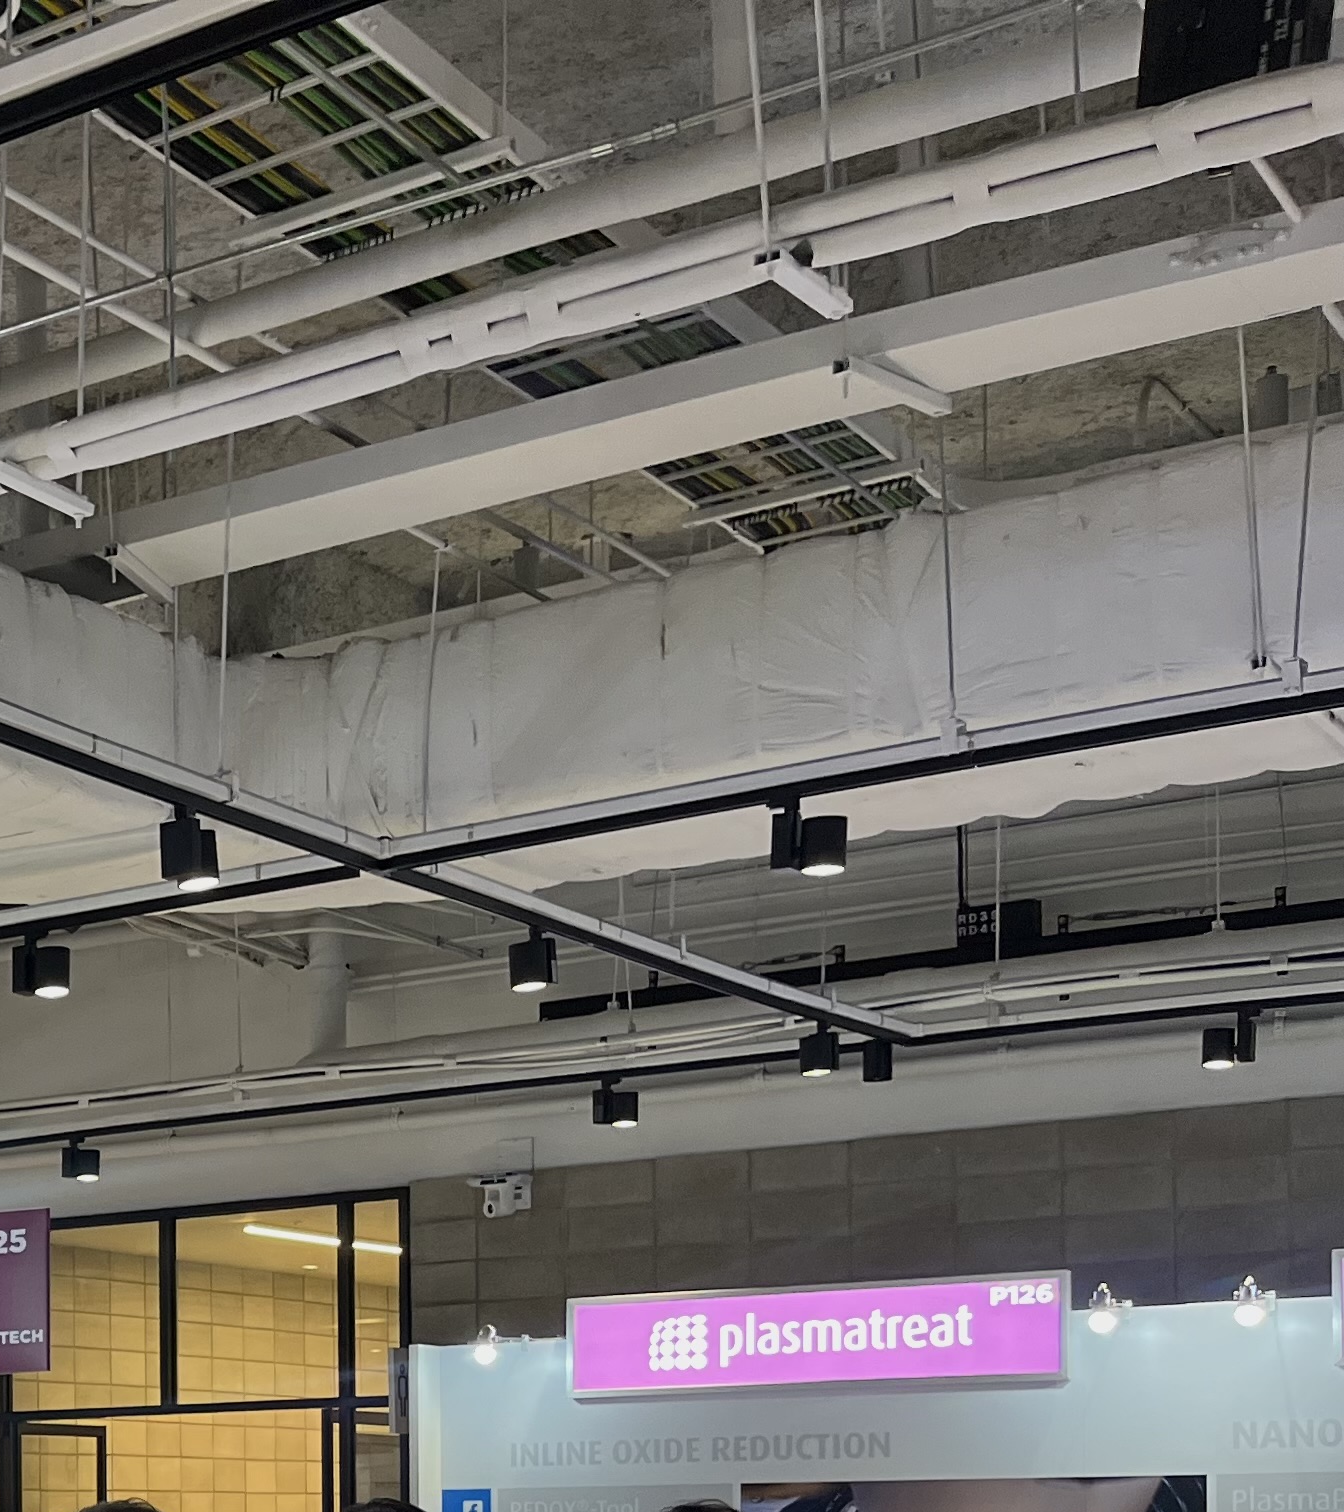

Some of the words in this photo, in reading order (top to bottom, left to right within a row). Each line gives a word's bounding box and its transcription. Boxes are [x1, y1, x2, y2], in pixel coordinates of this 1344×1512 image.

[989, 1283, 1054, 1306] P126
[719, 1304, 974, 1368] plasmatreat
[510, 1440, 603, 1468] INLINE
[611, 1436, 701, 1465] OXIDE
[711, 1431, 892, 1462] REDUCTION
[1232, 1417, 1343, 1450] NANO
